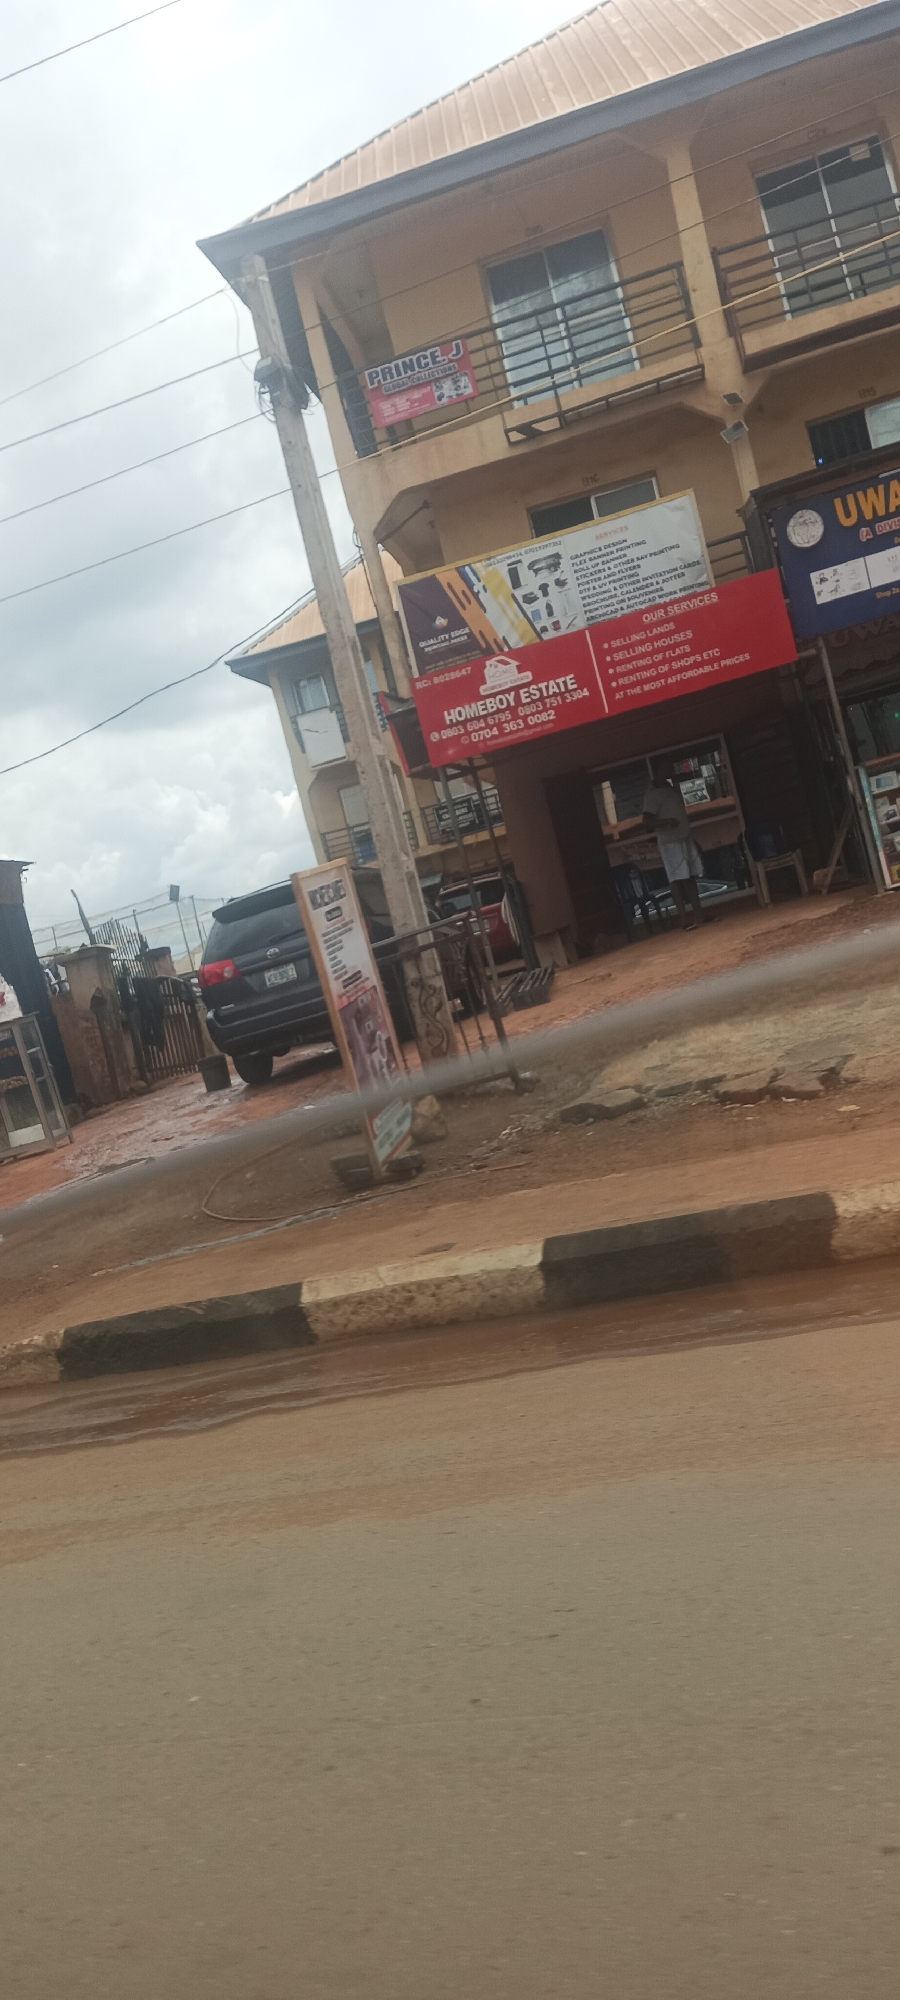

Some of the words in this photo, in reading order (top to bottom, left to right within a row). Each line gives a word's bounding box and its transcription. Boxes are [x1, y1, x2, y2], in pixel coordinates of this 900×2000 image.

[448, 340, 463, 359] J
[383, 379, 409, 393] GLOBAL
[410, 364, 457, 384] COLLECTIONS
[595, 525, 629, 540] SERVICES
[570, 547, 602, 560] GRAPHICS
[603, 538, 628, 550] DESIGN
[571, 559, 587, 567] FLEX
[588, 550, 615, 562] BANNER
[616, 540, 647, 554] PRINTING
[576, 568, 606, 581] STICKERS
[613, 558, 635, 569] OTHER
[649, 544, 680, 558] PRINTING
[573, 565, 590, 574] ROLL
[601, 554, 627, 565] BANNER
[577, 576, 602, 588] POSTER
[603, 572, 618, 580] AND
[618, 564, 641, 575] FLYERS
[580, 587, 612, 602] WEDDING
[619, 578, 640, 590] OTHER
[642, 567, 678, 582] INVITATION
[680, 560, 701, 571] CARDS
[608, 572, 640, 586] PRINTING
[621, 582, 654, 596] CALENDER
[662, 572, 685, 584] JOTTER
[584, 602, 615, 615] PRINTING
[627, 588, 664, 602] SOUVENIRS
[586, 608, 619, 622] ARCHICAD
[626, 596, 656, 610] AUTOCAD
[658, 590, 678, 600] WORK
[678, 581, 709, 593] PRINTING
[642, 608, 665, 623] OUR
[666, 592, 719, 616] SERVICES
[419, 633, 450, 648] QUALITY
[450, 627, 470, 637] EDGE
[610, 630, 646, 648] SELLING
[647, 621, 675, 637] LANDS
[613, 642, 652, 661] SELLING
[654, 629, 693, 649] HOUSES
[616, 657, 652, 674] RENTING
[653, 652, 665, 661] OF
[665, 644, 691, 658] FLATS
[618, 667, 657, 686] RENTING
[657, 663, 670, 673] OF
[671, 654, 702, 670] SHOPS
[703, 647, 721, 660] ETC
[488, 668, 515, 680] HOME
[614, 691, 626, 700] AT
[626, 686, 642, 697] THE
[643, 678, 666, 692] MOST
[667, 663, 720, 684] AFFORDABLE
[720, 652, 751, 668] PRICES
[443, 691, 515, 725] HOMEBOY
[519, 673, 578, 704] ESTATE
[440, 725, 465, 740] 0803
[467, 719, 485, 732] 604
[487, 711, 512, 725] 6795
[518, 702, 543, 717] 0803
[544, 696, 562, 708] 751
[565, 687, 590, 703] 3304
[471, 727, 499, 742] 0704
[502, 719, 524, 733] 363
[528, 710, 556, 725] 0082
